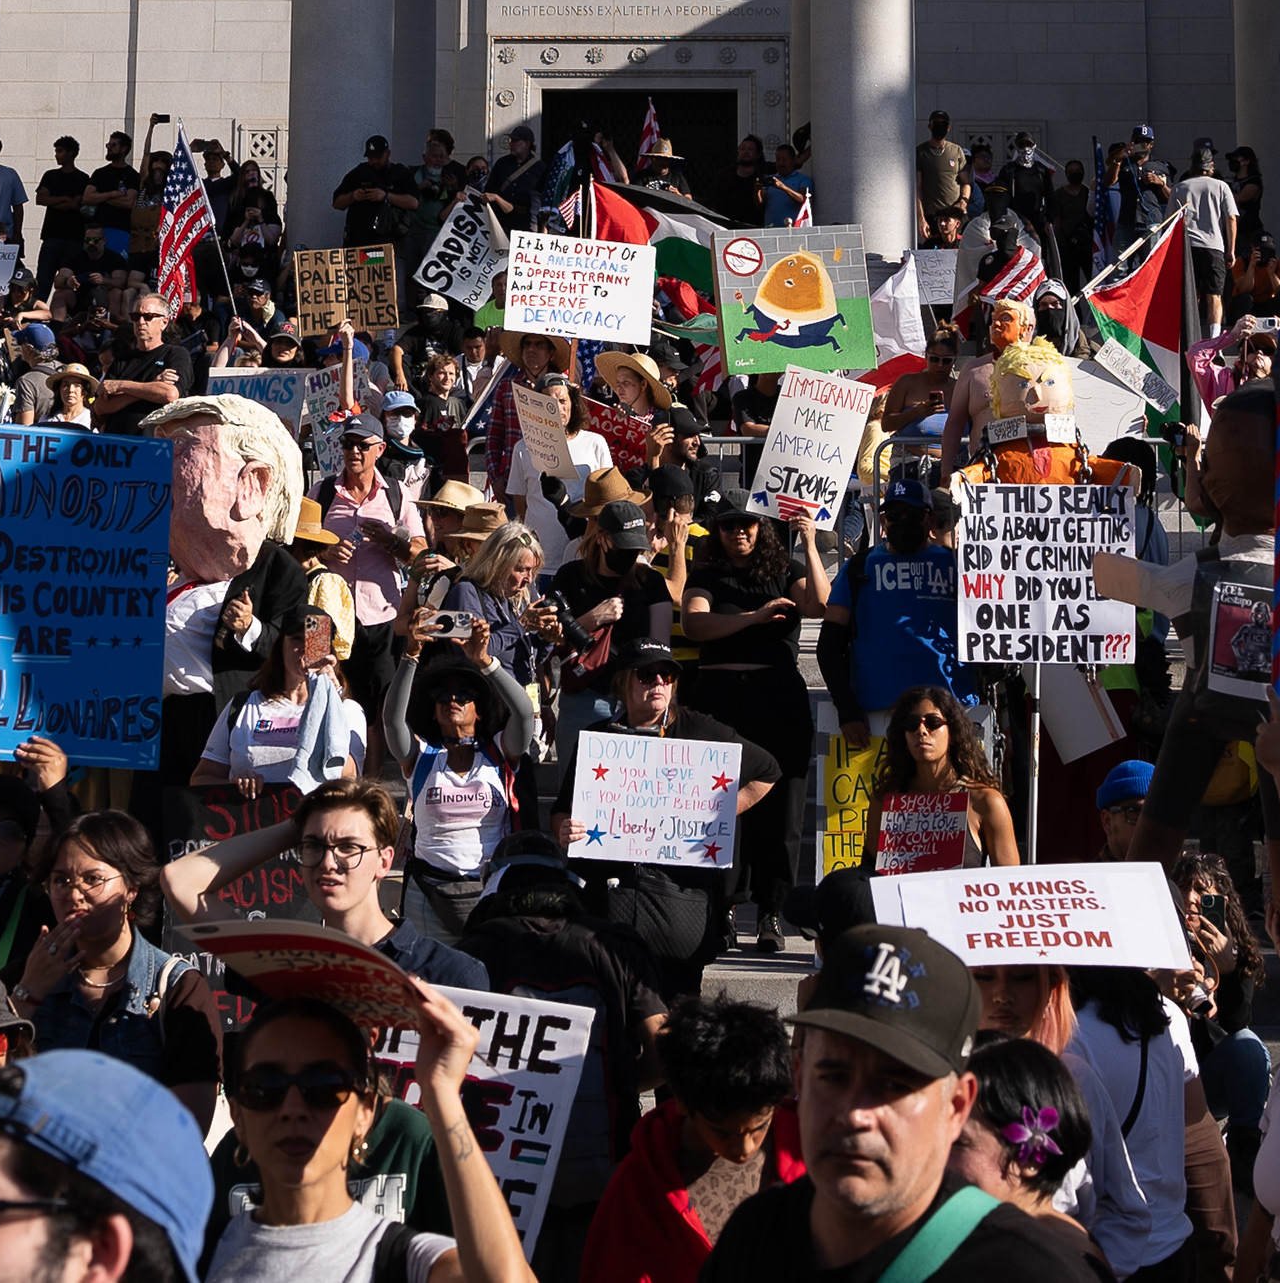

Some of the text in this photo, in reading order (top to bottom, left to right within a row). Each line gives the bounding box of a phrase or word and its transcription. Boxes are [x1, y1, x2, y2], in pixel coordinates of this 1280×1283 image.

[597, 4, 781, 17] EXALTETH A SOLOMON
[422, 192, 486, 293] SADISM
[466, 238, 485, 265] NOT
[574, 243, 617, 259] DUTY
[300, 249, 357, 267] FREE
[514, 252, 629, 273] ALL AMERICANS
[300, 265, 392, 288] PALESTINE
[462, 258, 499, 306] POLITICAL
[527, 267, 566, 279] OPPOSE
[301, 284, 388, 305] RELEASE
[539, 280, 589, 295] FIGHT
[511, 294, 589, 310] PRESERVE
[300, 310, 336, 331] THE
[523, 307, 626, 330] DEMOCRACY
[238, 375, 297, 405] KINGS
[781, 370, 874, 415] IMMIGRANTS
[794, 406, 836, 432] MAKE
[69, 439, 138, 470] ONLY
[771, 431, 843, 465] AMERICA
[765, 465, 838, 510] STRONG
[894, 481, 907, 496] LA
[995, 486, 1128, 515] THIS REALLY
[964, 517, 1131, 544] WAS ABOUT GETTING
[963, 544, 1022, 571] RID OF
[875, 562, 912, 591] ICE
[963, 574, 1082, 600] WHY DID YOU
[32, 582, 161, 618] COUNTRY
[976, 604, 1091, 632] ONE AS
[14, 626, 72, 656] ARE
[967, 632, 1131, 663] PRESIDENT???
[589, 736, 652, 763] DON'T
[627, 780, 700, 797] AMERICA
[901, 793, 952, 810] SHOULD
[664, 816, 731, 840] JUSTICE
[884, 828, 961, 847] MY COUNTRY
[964, 879, 1096, 898] NO KINGS.
[959, 896, 1107, 914] NO MASTERS.
[998, 912, 1071, 930] JUST
[965, 930, 1113, 949] FREEDOM
[863, 941, 909, 1002] LA
[462, 1004, 574, 1076] THE
